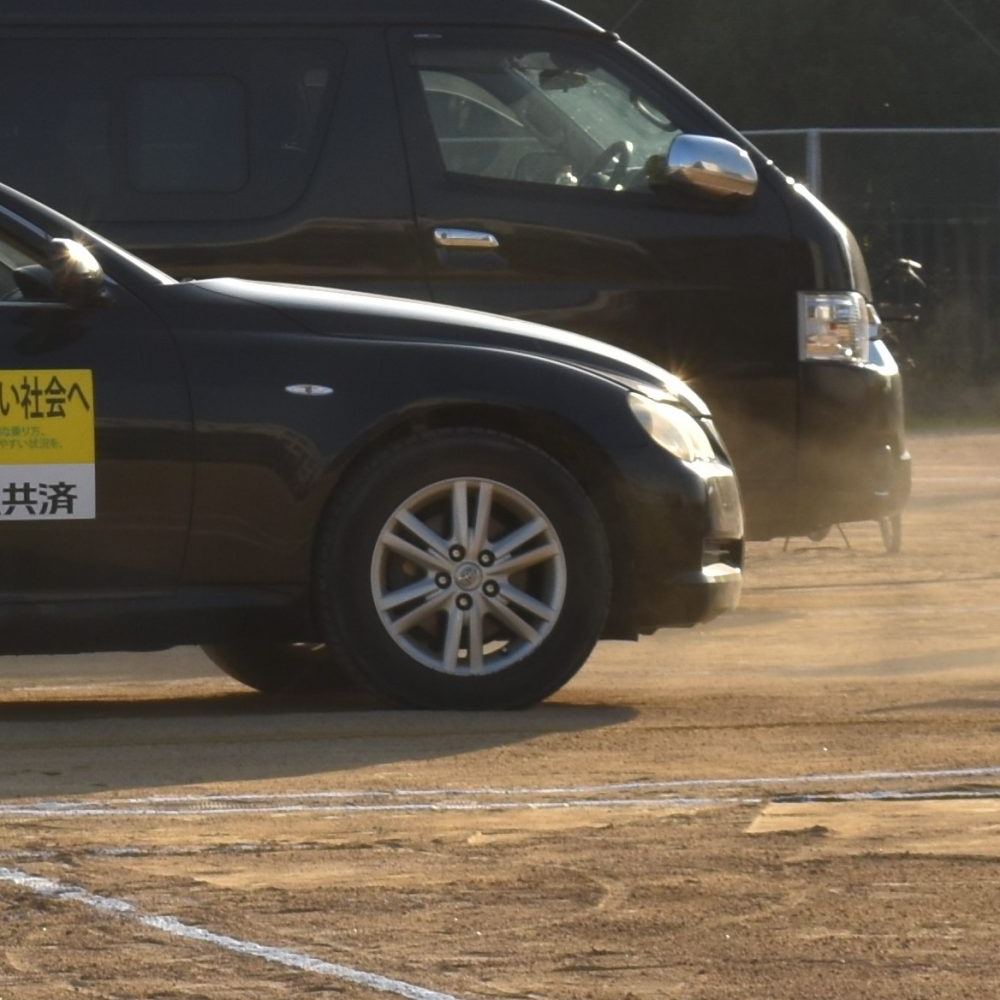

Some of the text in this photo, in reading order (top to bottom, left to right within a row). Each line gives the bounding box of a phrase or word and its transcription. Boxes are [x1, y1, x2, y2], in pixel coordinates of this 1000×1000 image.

[0, 376, 91, 419] い社会へ
[0, 426, 45, 437] な乗り方、
[0, 481, 78, 515] 共済
